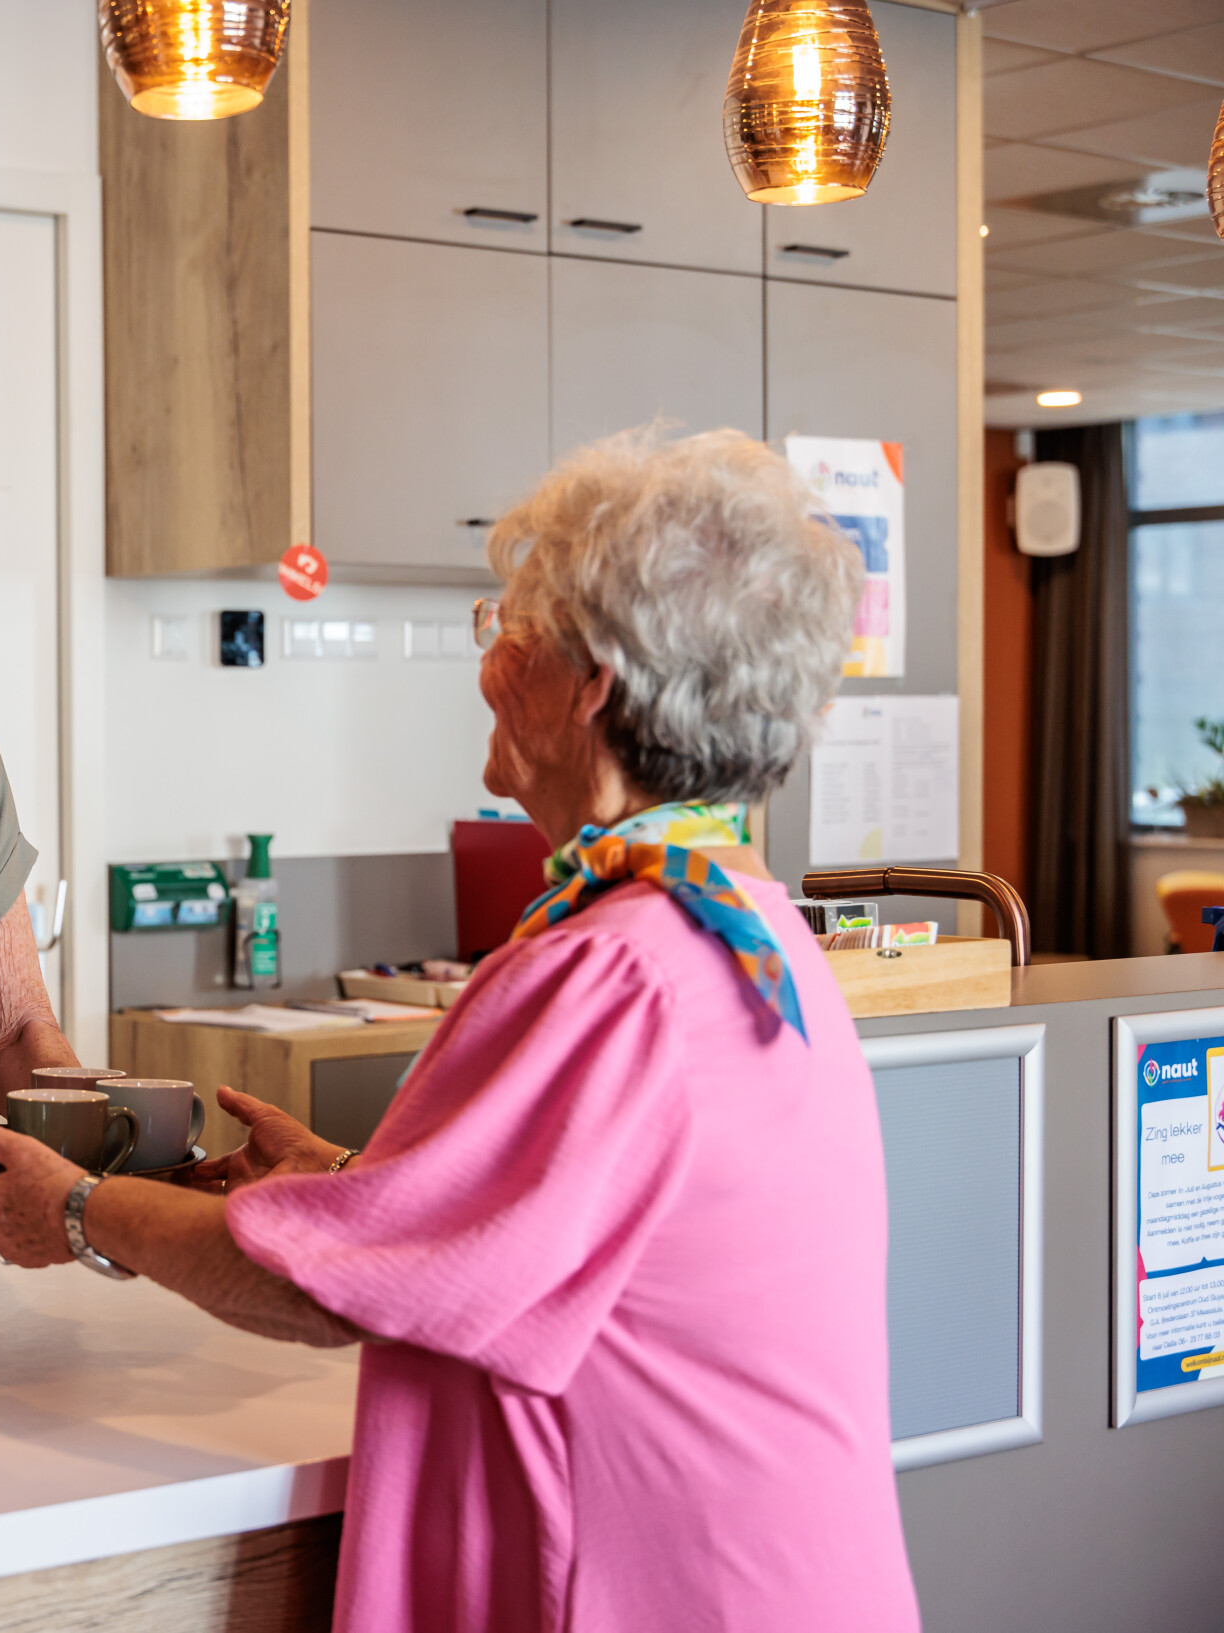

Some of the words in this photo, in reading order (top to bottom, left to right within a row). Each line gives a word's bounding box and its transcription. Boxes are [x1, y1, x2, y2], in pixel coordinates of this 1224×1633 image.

[834, 468, 879, 488] naut
[1161, 1058, 1198, 1079] naut
[1145, 1126, 1168, 1141] Zing
[1170, 1121, 1203, 1137] lekker
[1161, 1153, 1185, 1165] mee
